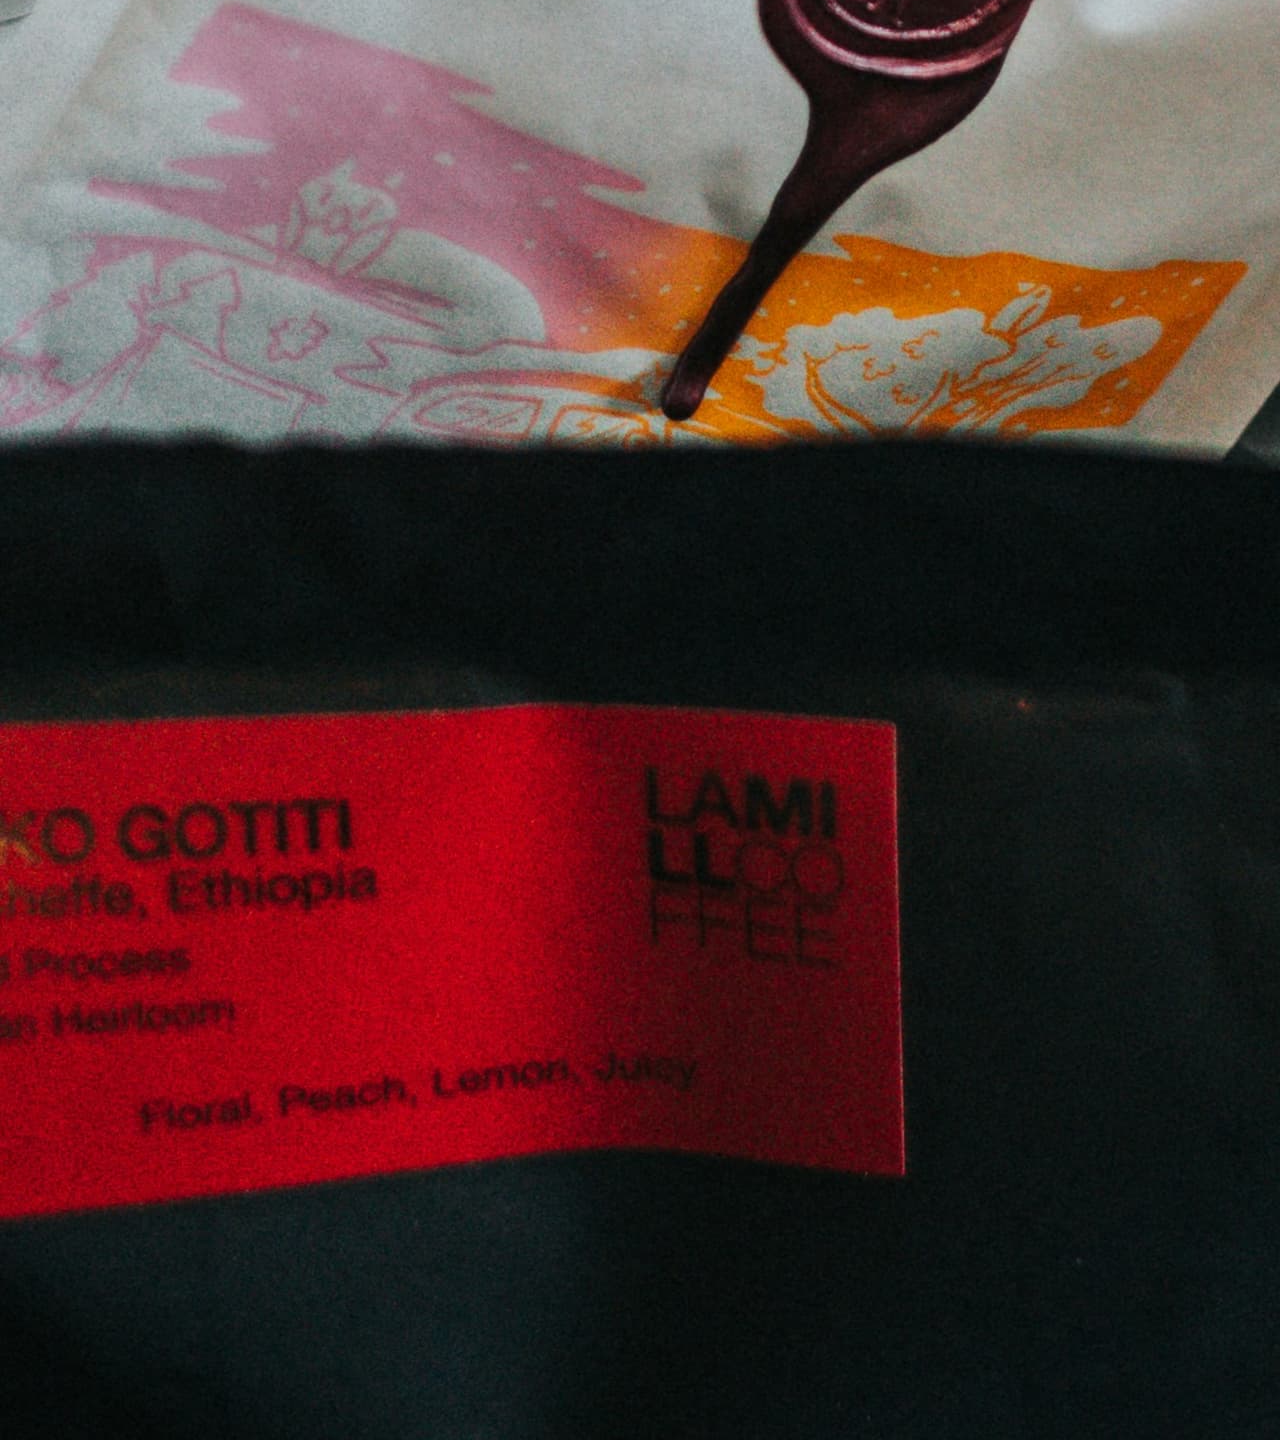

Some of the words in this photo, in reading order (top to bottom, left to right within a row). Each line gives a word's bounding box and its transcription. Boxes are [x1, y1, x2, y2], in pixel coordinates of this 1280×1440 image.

[117, 796, 353, 864] GOTITI
[642, 763, 839, 840] LAMI
[167, 862, 379, 914] Ethiopia
[277, 1074, 421, 1119] Peach,
[432, 1051, 581, 1100] Lemon,
